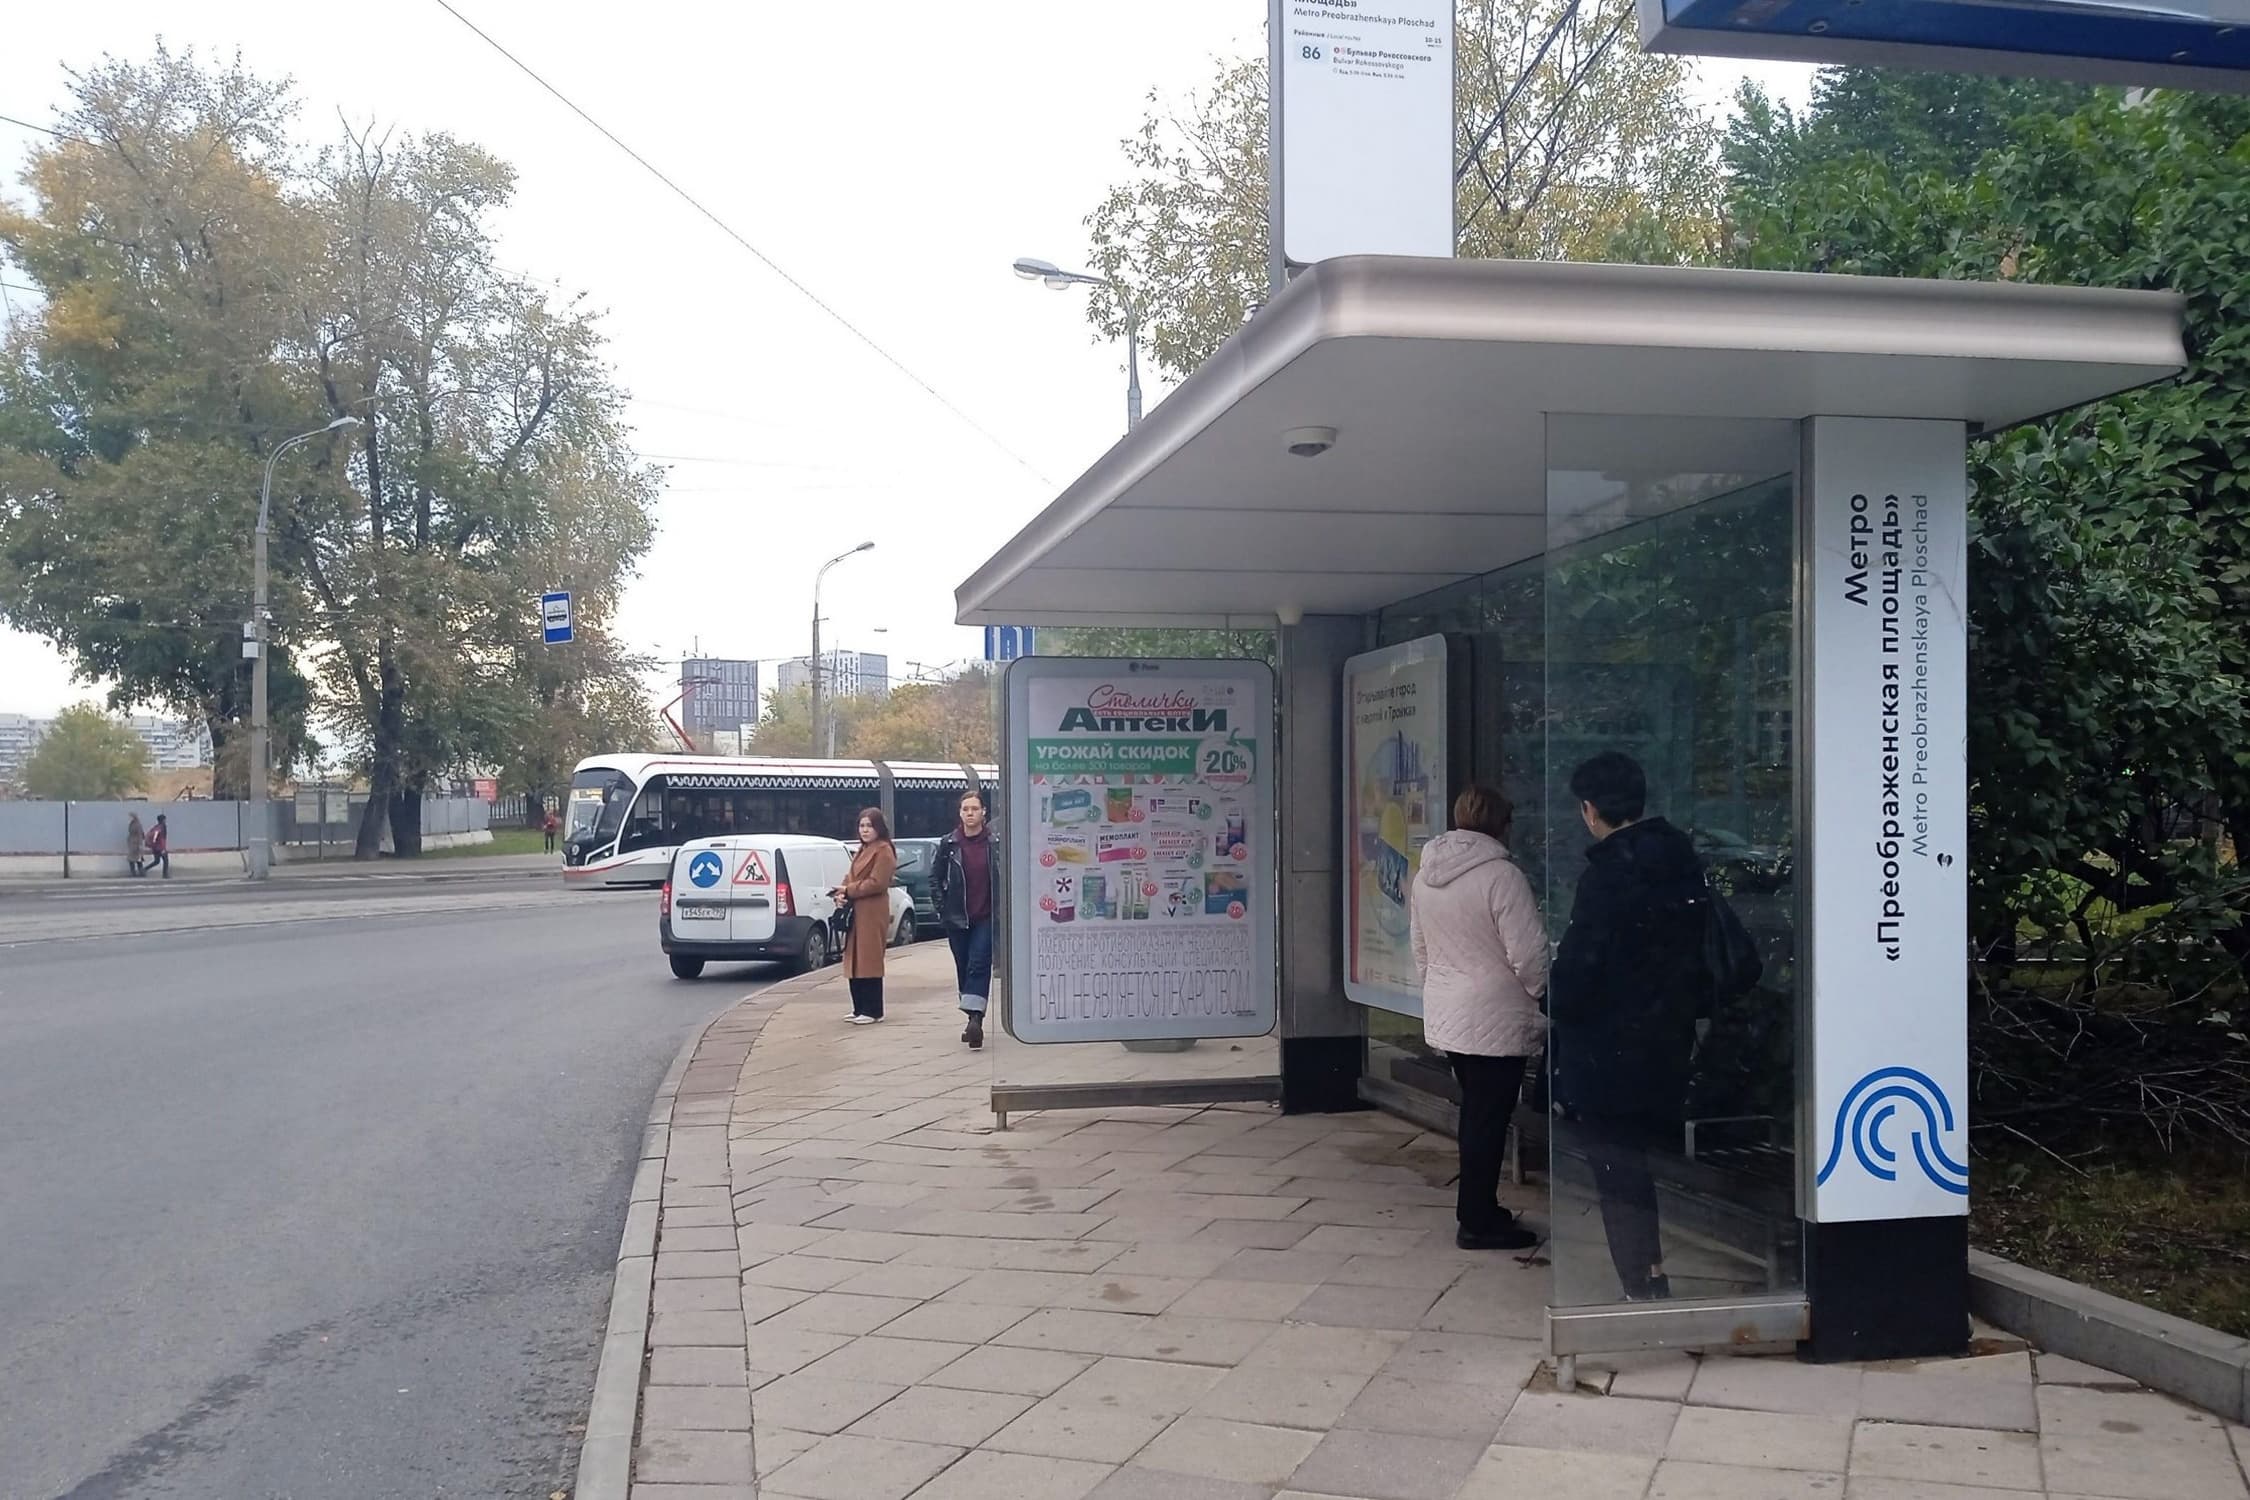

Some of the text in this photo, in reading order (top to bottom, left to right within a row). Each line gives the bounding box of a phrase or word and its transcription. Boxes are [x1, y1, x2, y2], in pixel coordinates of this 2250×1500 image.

[1294, 8, 1436, 28] Metro Preobrazhenskaya Ploschad
[1302, 45, 1321, 60] 86
[1347, 48, 1432, 62] Бульвар Рокоссовского
[1845, 494, 1873, 607] Метро
[1911, 495, 1931, 857] Metro Preobrazhenskaya Ploschad
[1087, 684, 1199, 710] Столички
[1876, 493, 1905, 962] «Преображенская площадь»
[1036, 742, 1190, 761] УРОЖАЙ СКИДОК
[1203, 750, 1247, 774] -20%
[1038, 950, 1249, 970] ПОЛУЧЕНИЕ КОНСУЛЬТАЦИИ СПЕЦИАЛИСТА
[1073, 972, 1091, 1019] НЕ
[1093, 970, 1160, 1018] ЯВЛЯЕТСЯ
